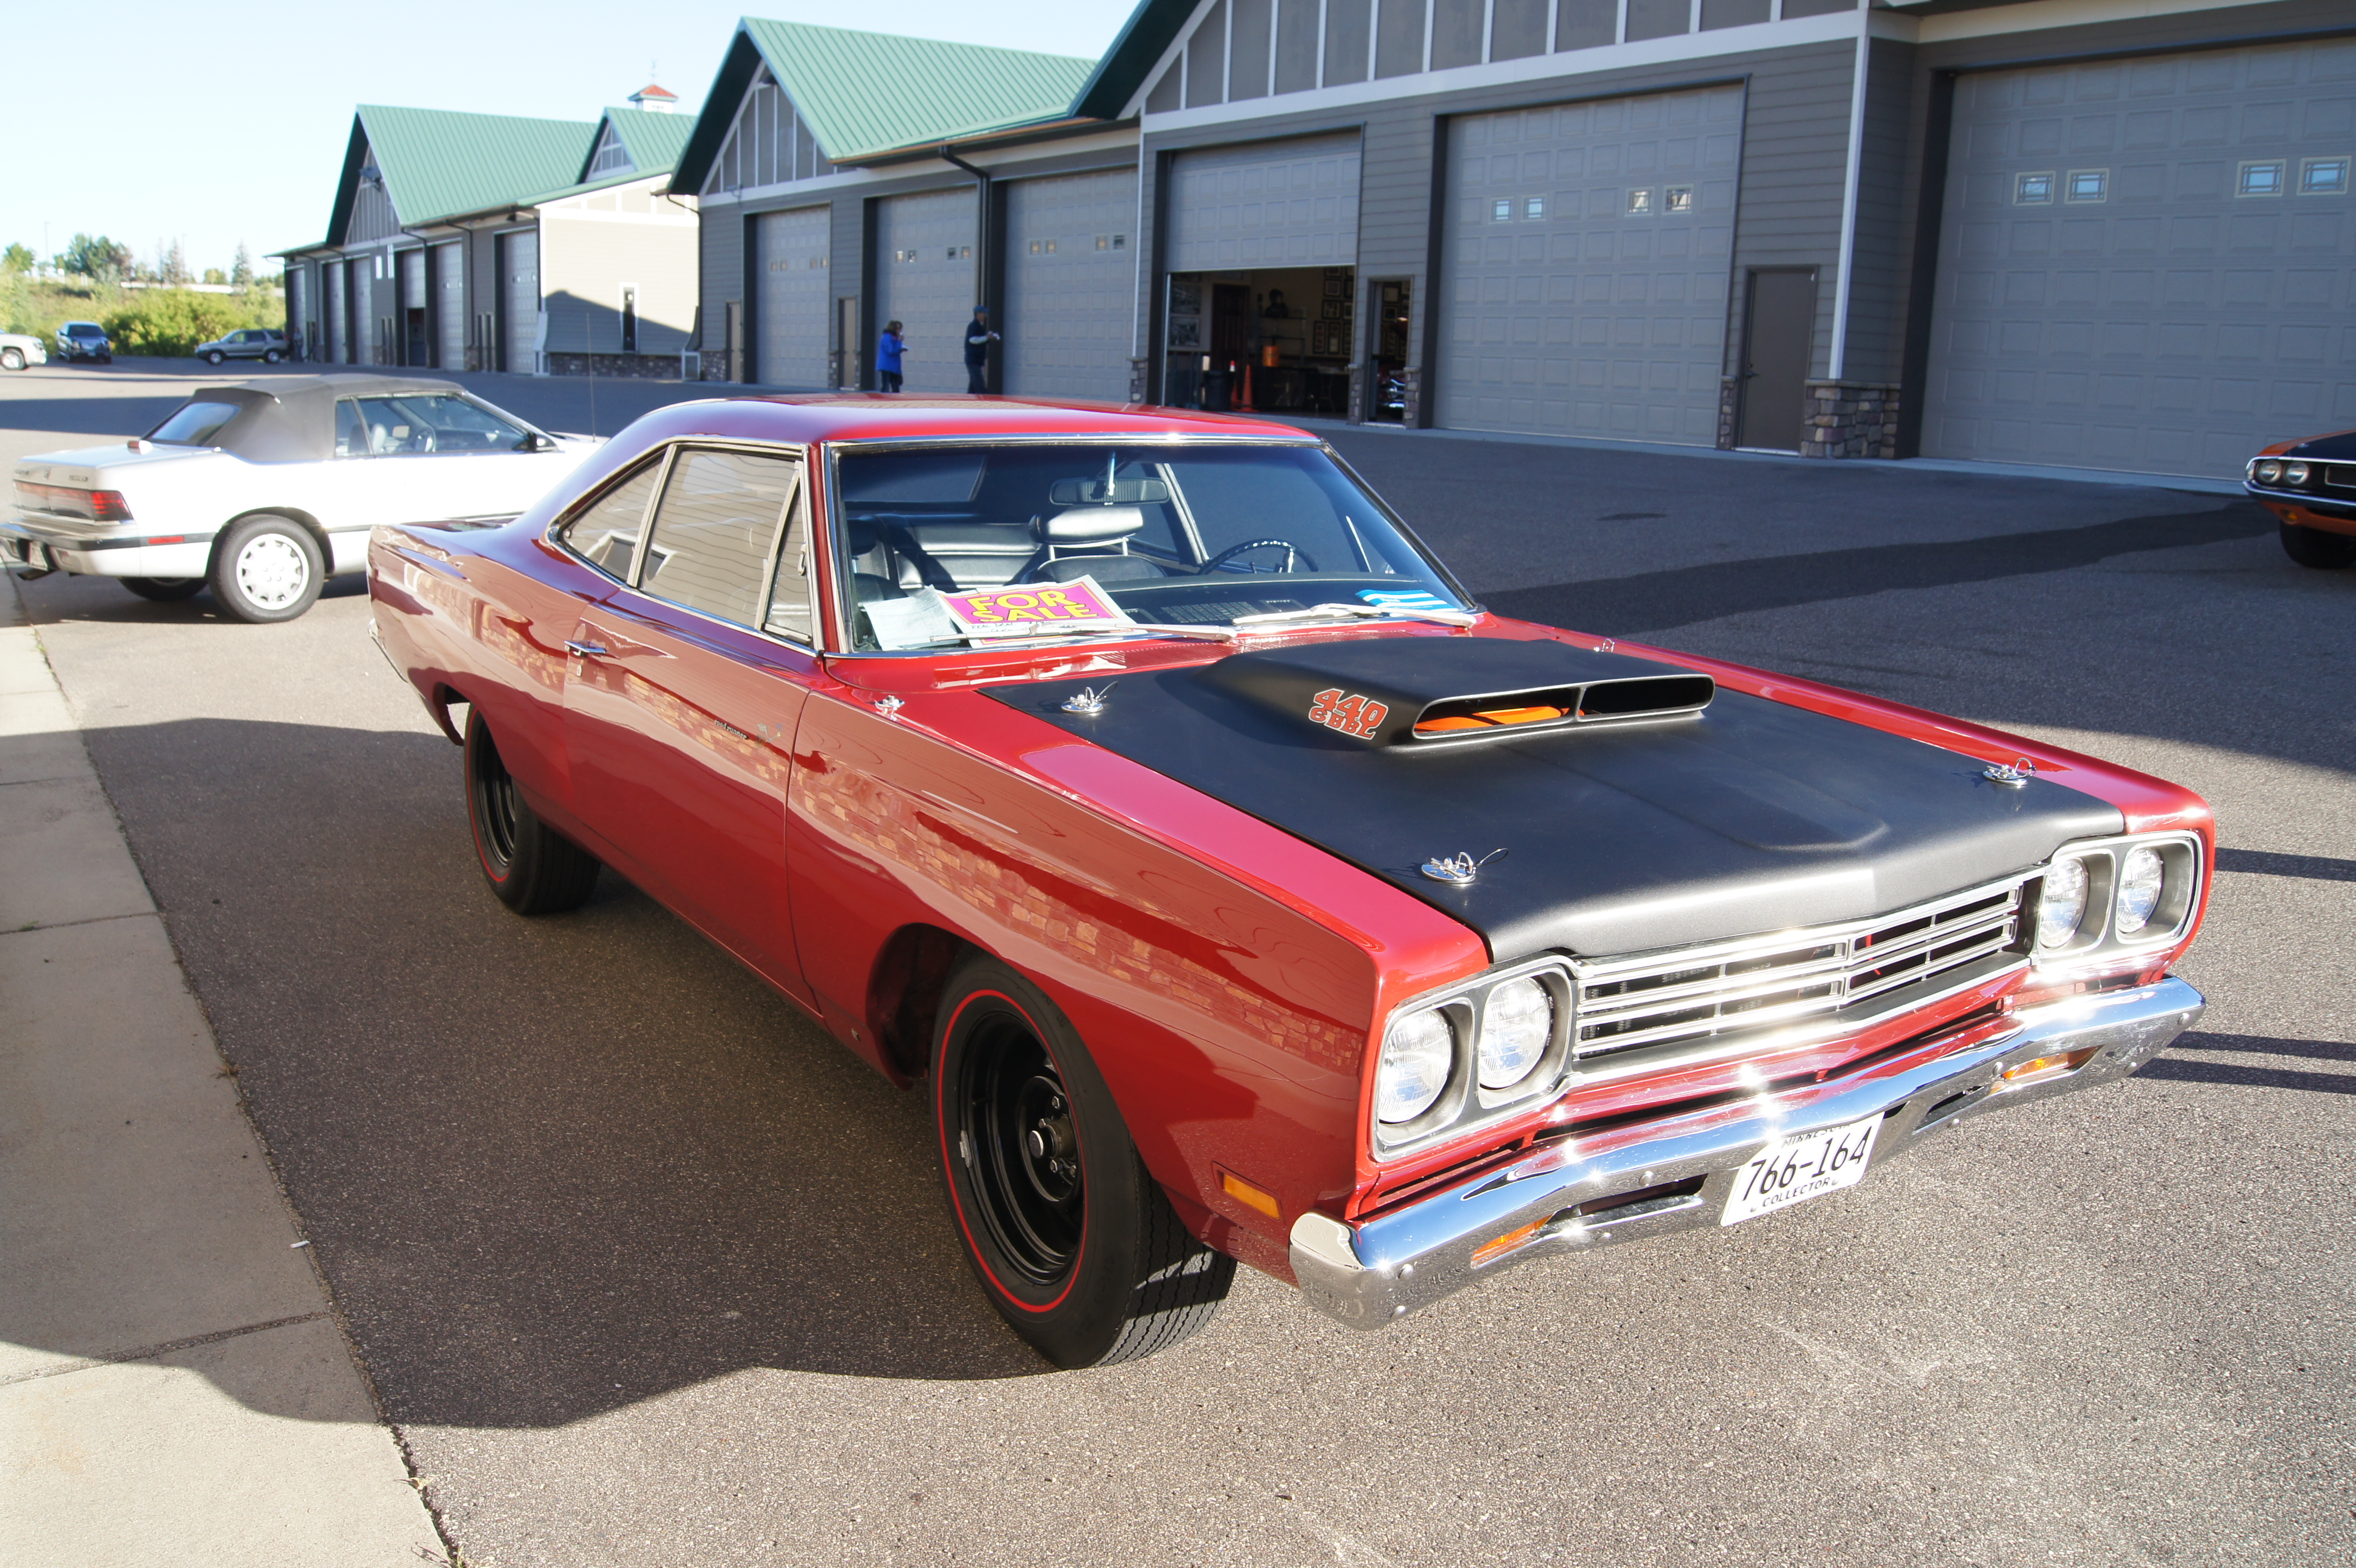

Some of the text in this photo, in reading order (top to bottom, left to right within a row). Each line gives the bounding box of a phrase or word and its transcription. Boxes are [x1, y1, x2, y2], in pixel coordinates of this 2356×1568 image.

[967, 590, 1078, 611] FOR
[972, 604, 1098, 622] SALE
[1313, 688, 1388, 728] 440
[714, 719, 747, 740] road runner
[1742, 1126, 1872, 1202] 766-164
[1763, 1177, 1830, 1207] COLLECTOR
